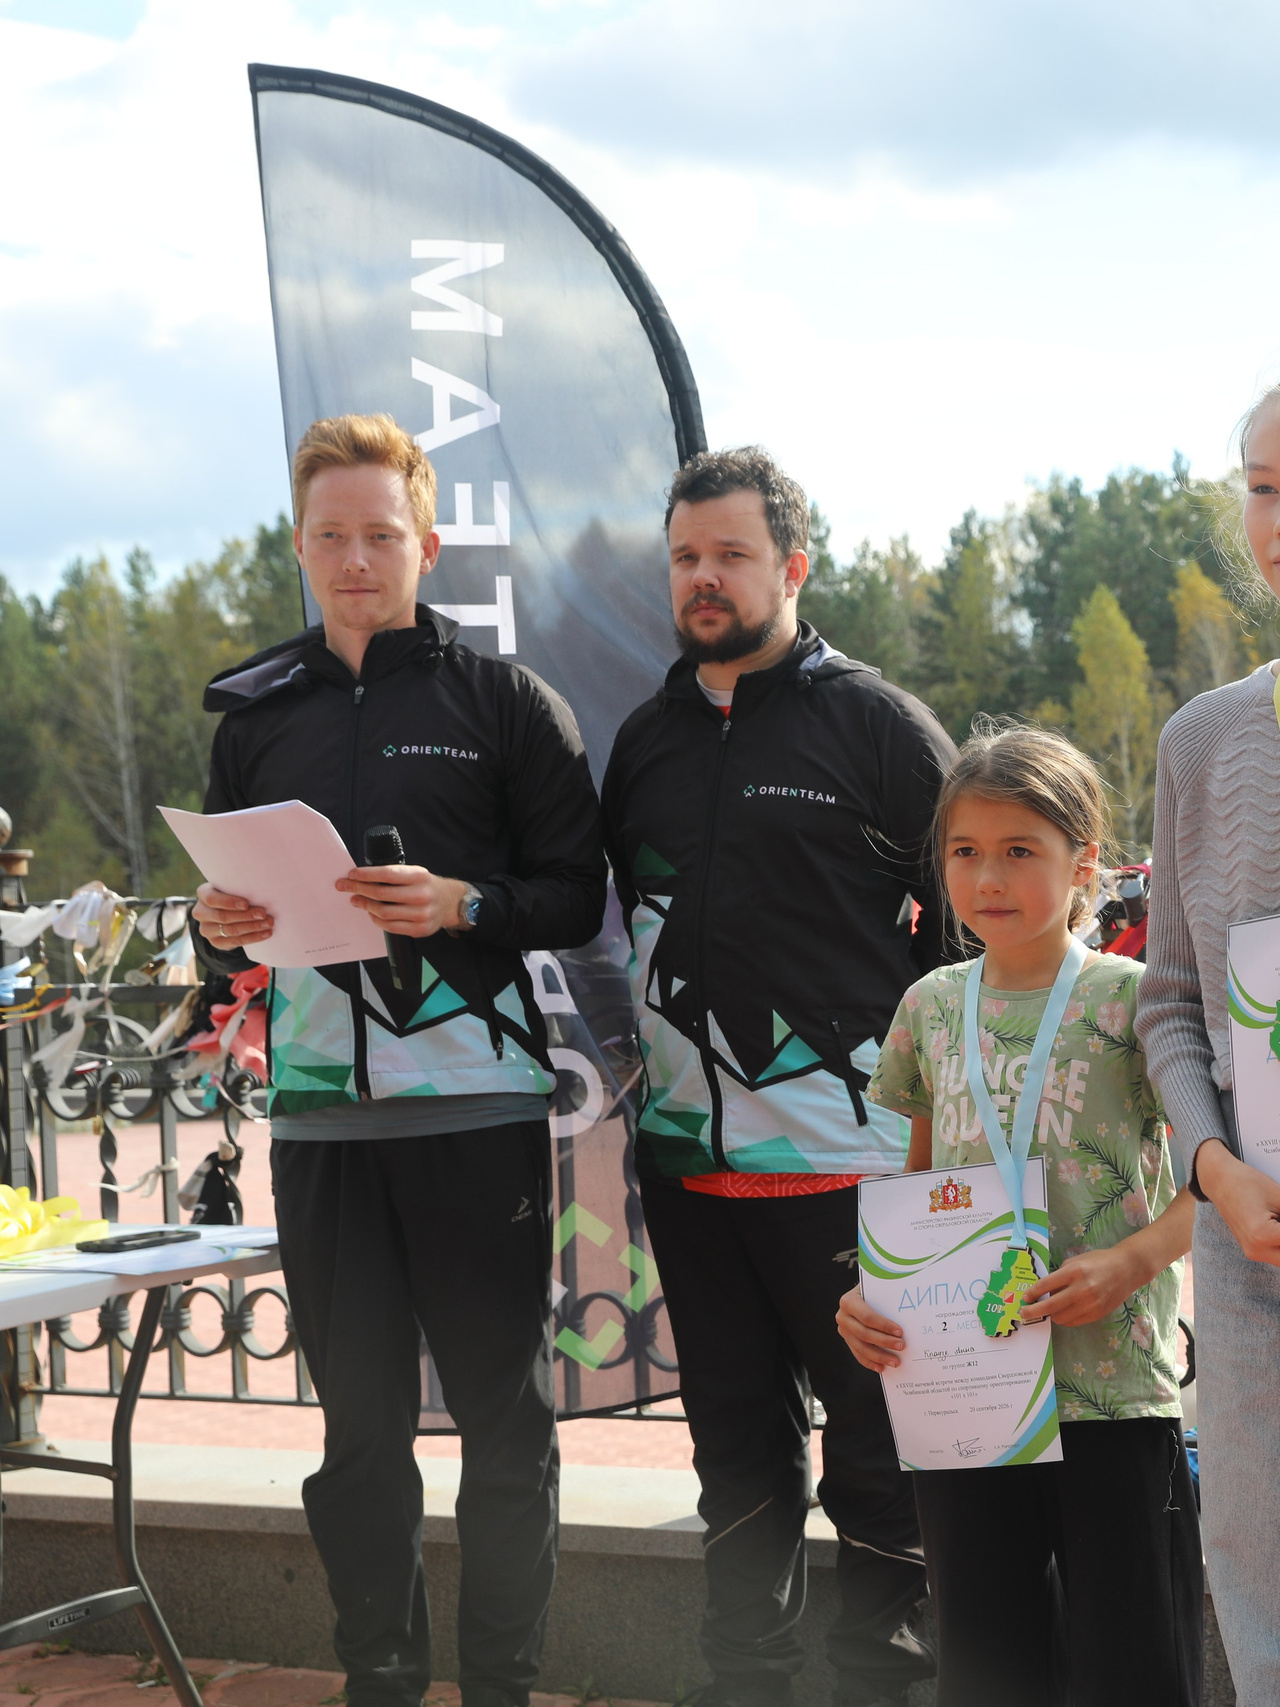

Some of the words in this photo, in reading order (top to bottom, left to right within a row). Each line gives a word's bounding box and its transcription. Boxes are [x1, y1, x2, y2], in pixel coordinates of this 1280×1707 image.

[401, 745, 478, 761] ORIENTEAM
[759, 786, 836, 804] ORIENTEAM
[910, 1218, 942, 1226] МИНИСТЕРСТВО
[935, 1220, 969, 1228] СВЕРДЛОВСКОЙ
[898, 1279, 988, 1313] ДИПЛО
[985, 1303, 1003, 1313] 101
[935, 1309, 975, 1319] награждается
[922, 1326, 934, 1335] ЗА
[942, 1321, 948, 1331] 2
[998, 1370, 1033, 1379] Свердловской
[990, 1379, 1031, 1388] ориентированию
